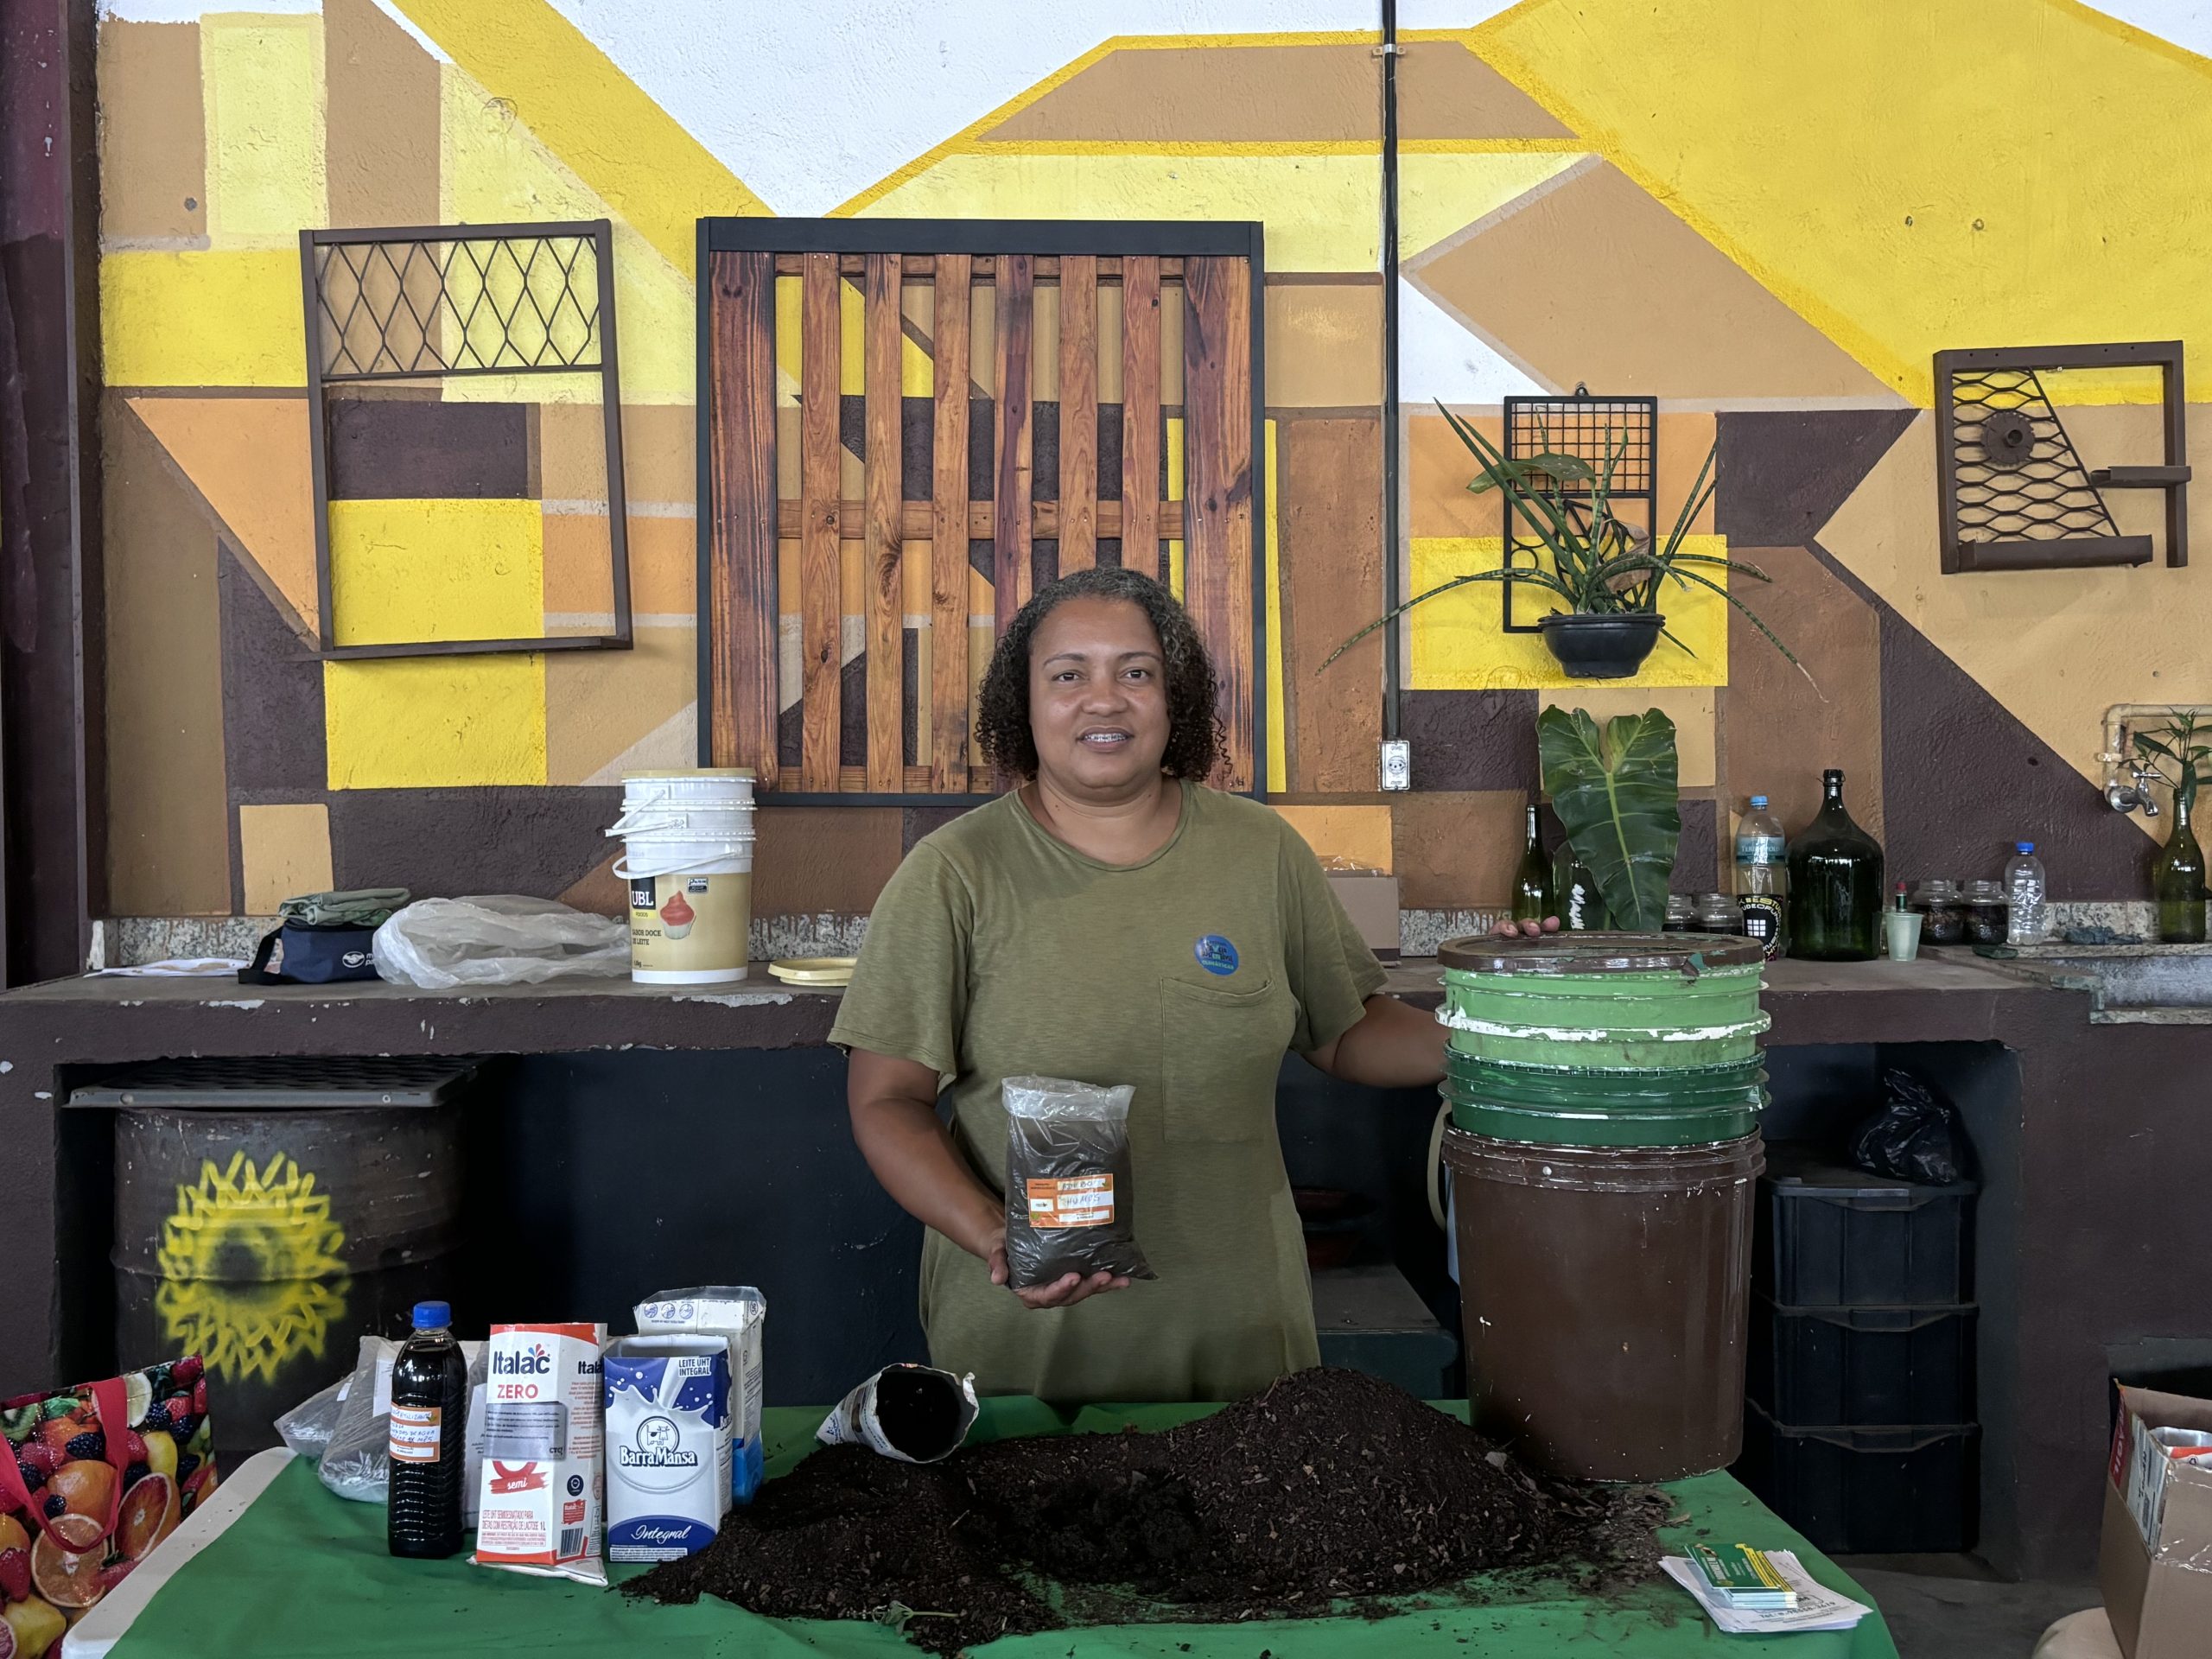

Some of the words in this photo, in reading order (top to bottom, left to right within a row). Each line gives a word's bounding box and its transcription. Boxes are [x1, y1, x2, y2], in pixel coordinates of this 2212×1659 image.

[645, 929, 662, 938] DOCE
[493, 1351, 550, 1375] Italac
[678, 1359, 696, 1368] LEITE
[696, 1358, 710, 1367] UHT
[679, 1367, 710, 1376] INTEGRAL
[497, 1384, 538, 1399] ZERO
[507, 1477, 528, 1491] semi
[631, 1524, 692, 1544] Integral
